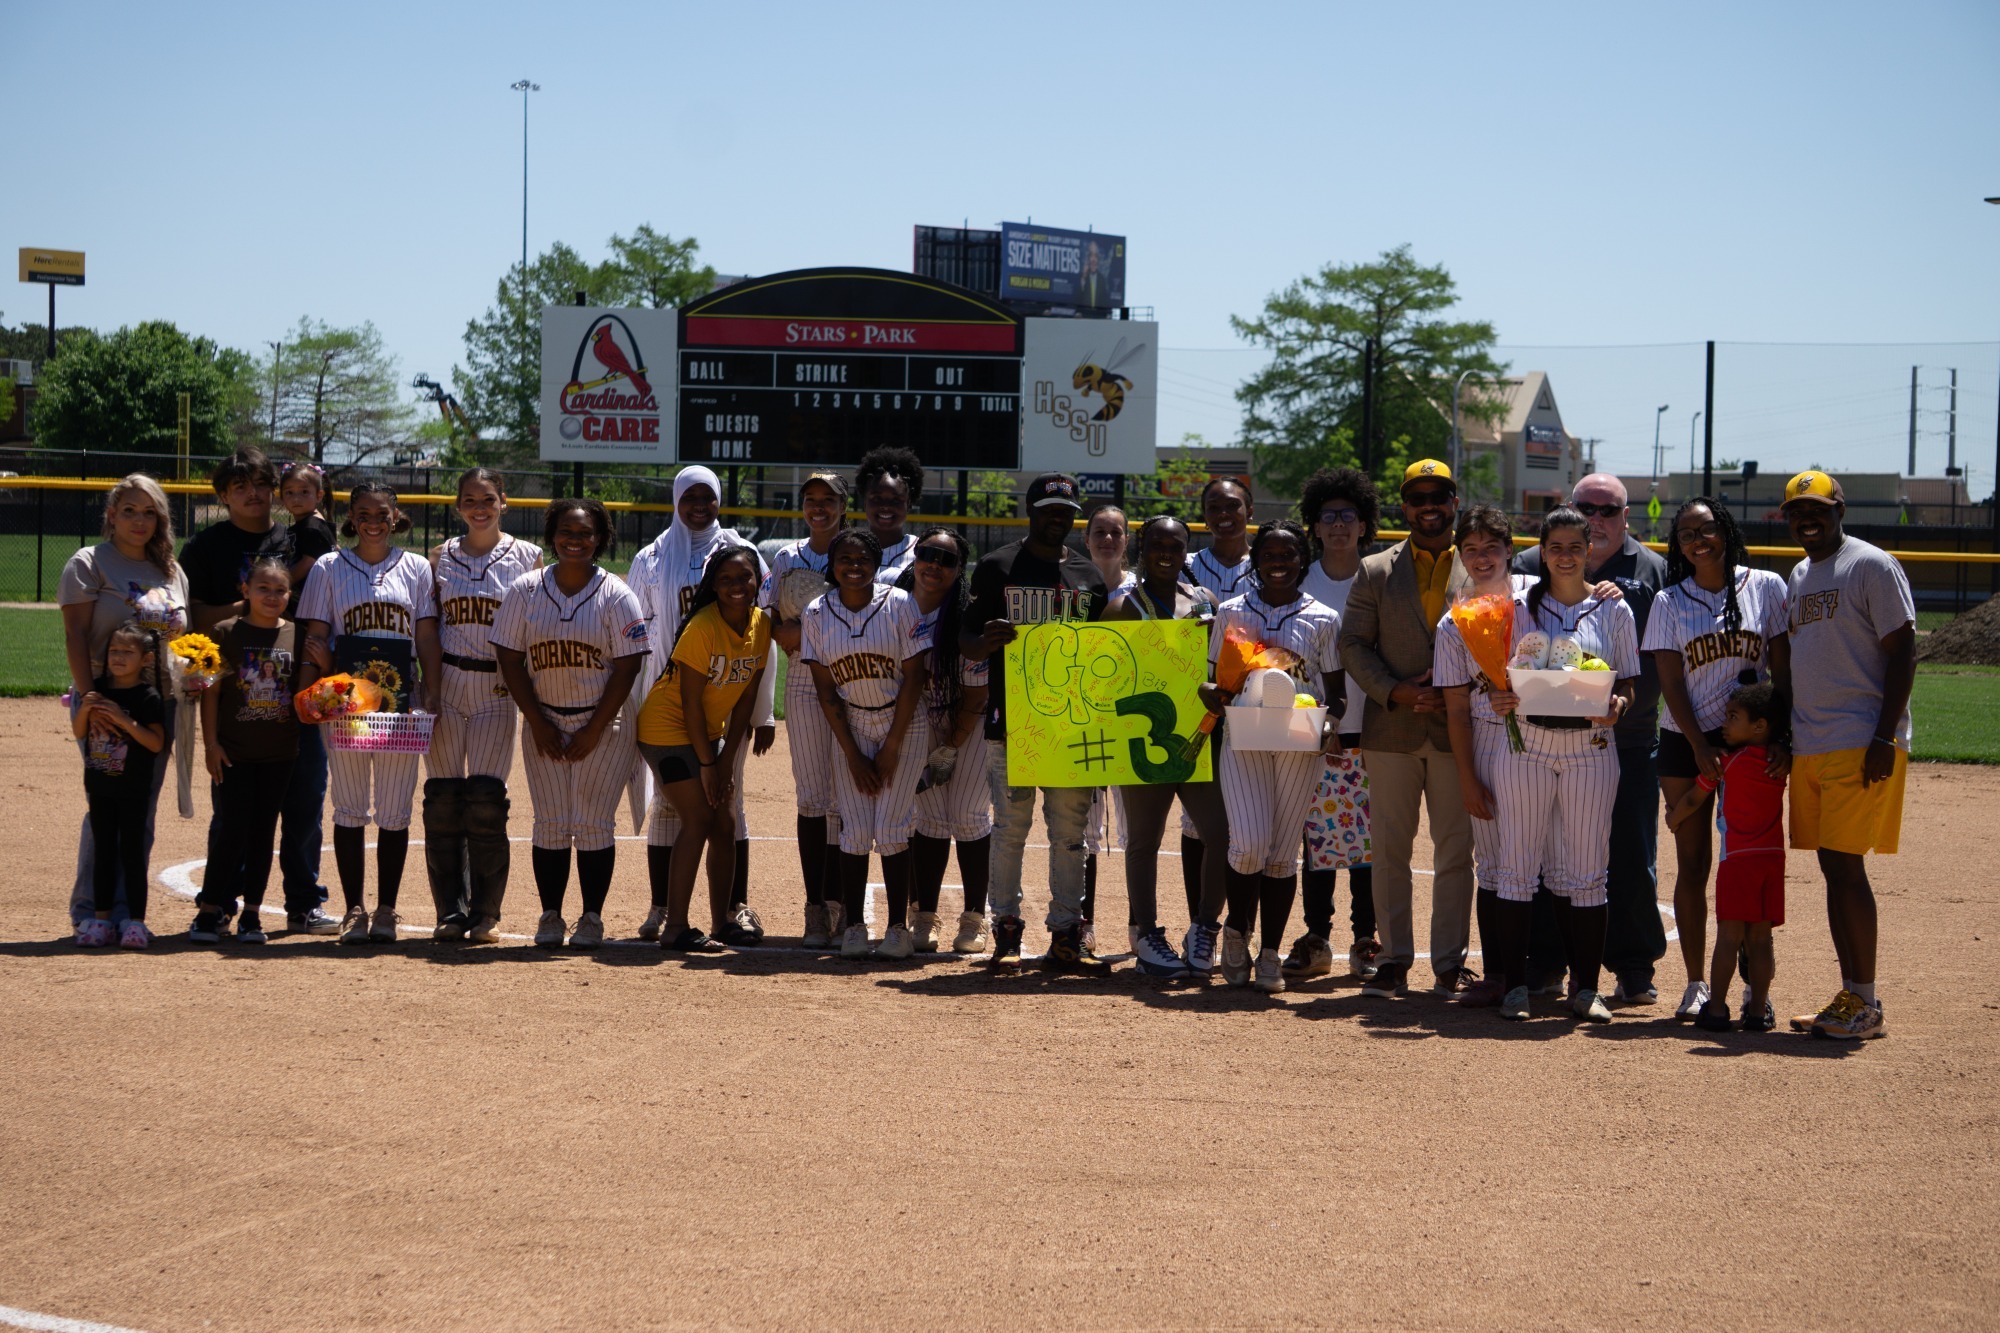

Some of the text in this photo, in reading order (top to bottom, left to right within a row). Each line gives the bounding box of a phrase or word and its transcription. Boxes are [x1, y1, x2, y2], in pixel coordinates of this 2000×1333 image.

[1008, 240, 1080, 274] SIZE MATTERS
[786, 323, 917, 344] STARS PARK
[689, 361, 724, 380] BALL
[796, 364, 848, 383] STRIKE
[935, 367, 964, 386] OUT
[560, 381, 660, 416] Cardinals
[794, 392, 800, 407] 1
[813, 393, 820, 408] 2
[833, 393, 841, 408] 3
[853, 394, 861, 408] 4
[873, 394, 881, 409] 5
[914, 395, 922, 410] 7
[934, 396, 942, 410] 8
[954, 396, 962, 411] 9
[981, 396, 1014, 412] TOTAL
[582, 416, 660, 443] CARE
[705, 414, 760, 434] GUESTS
[712, 440, 752, 459] HOME
[443, 595, 503, 627] HORNE
[1005, 586, 1092, 625] BULLS
[1798, 589, 1839, 626] 1857
[529, 639, 605, 673] HORNETS
[1685, 628, 1763, 674] HORNETS
[830, 652, 897, 687] HORNETS
[1023, 623, 1138, 725] GO
[1142, 671, 1168, 691] Big
